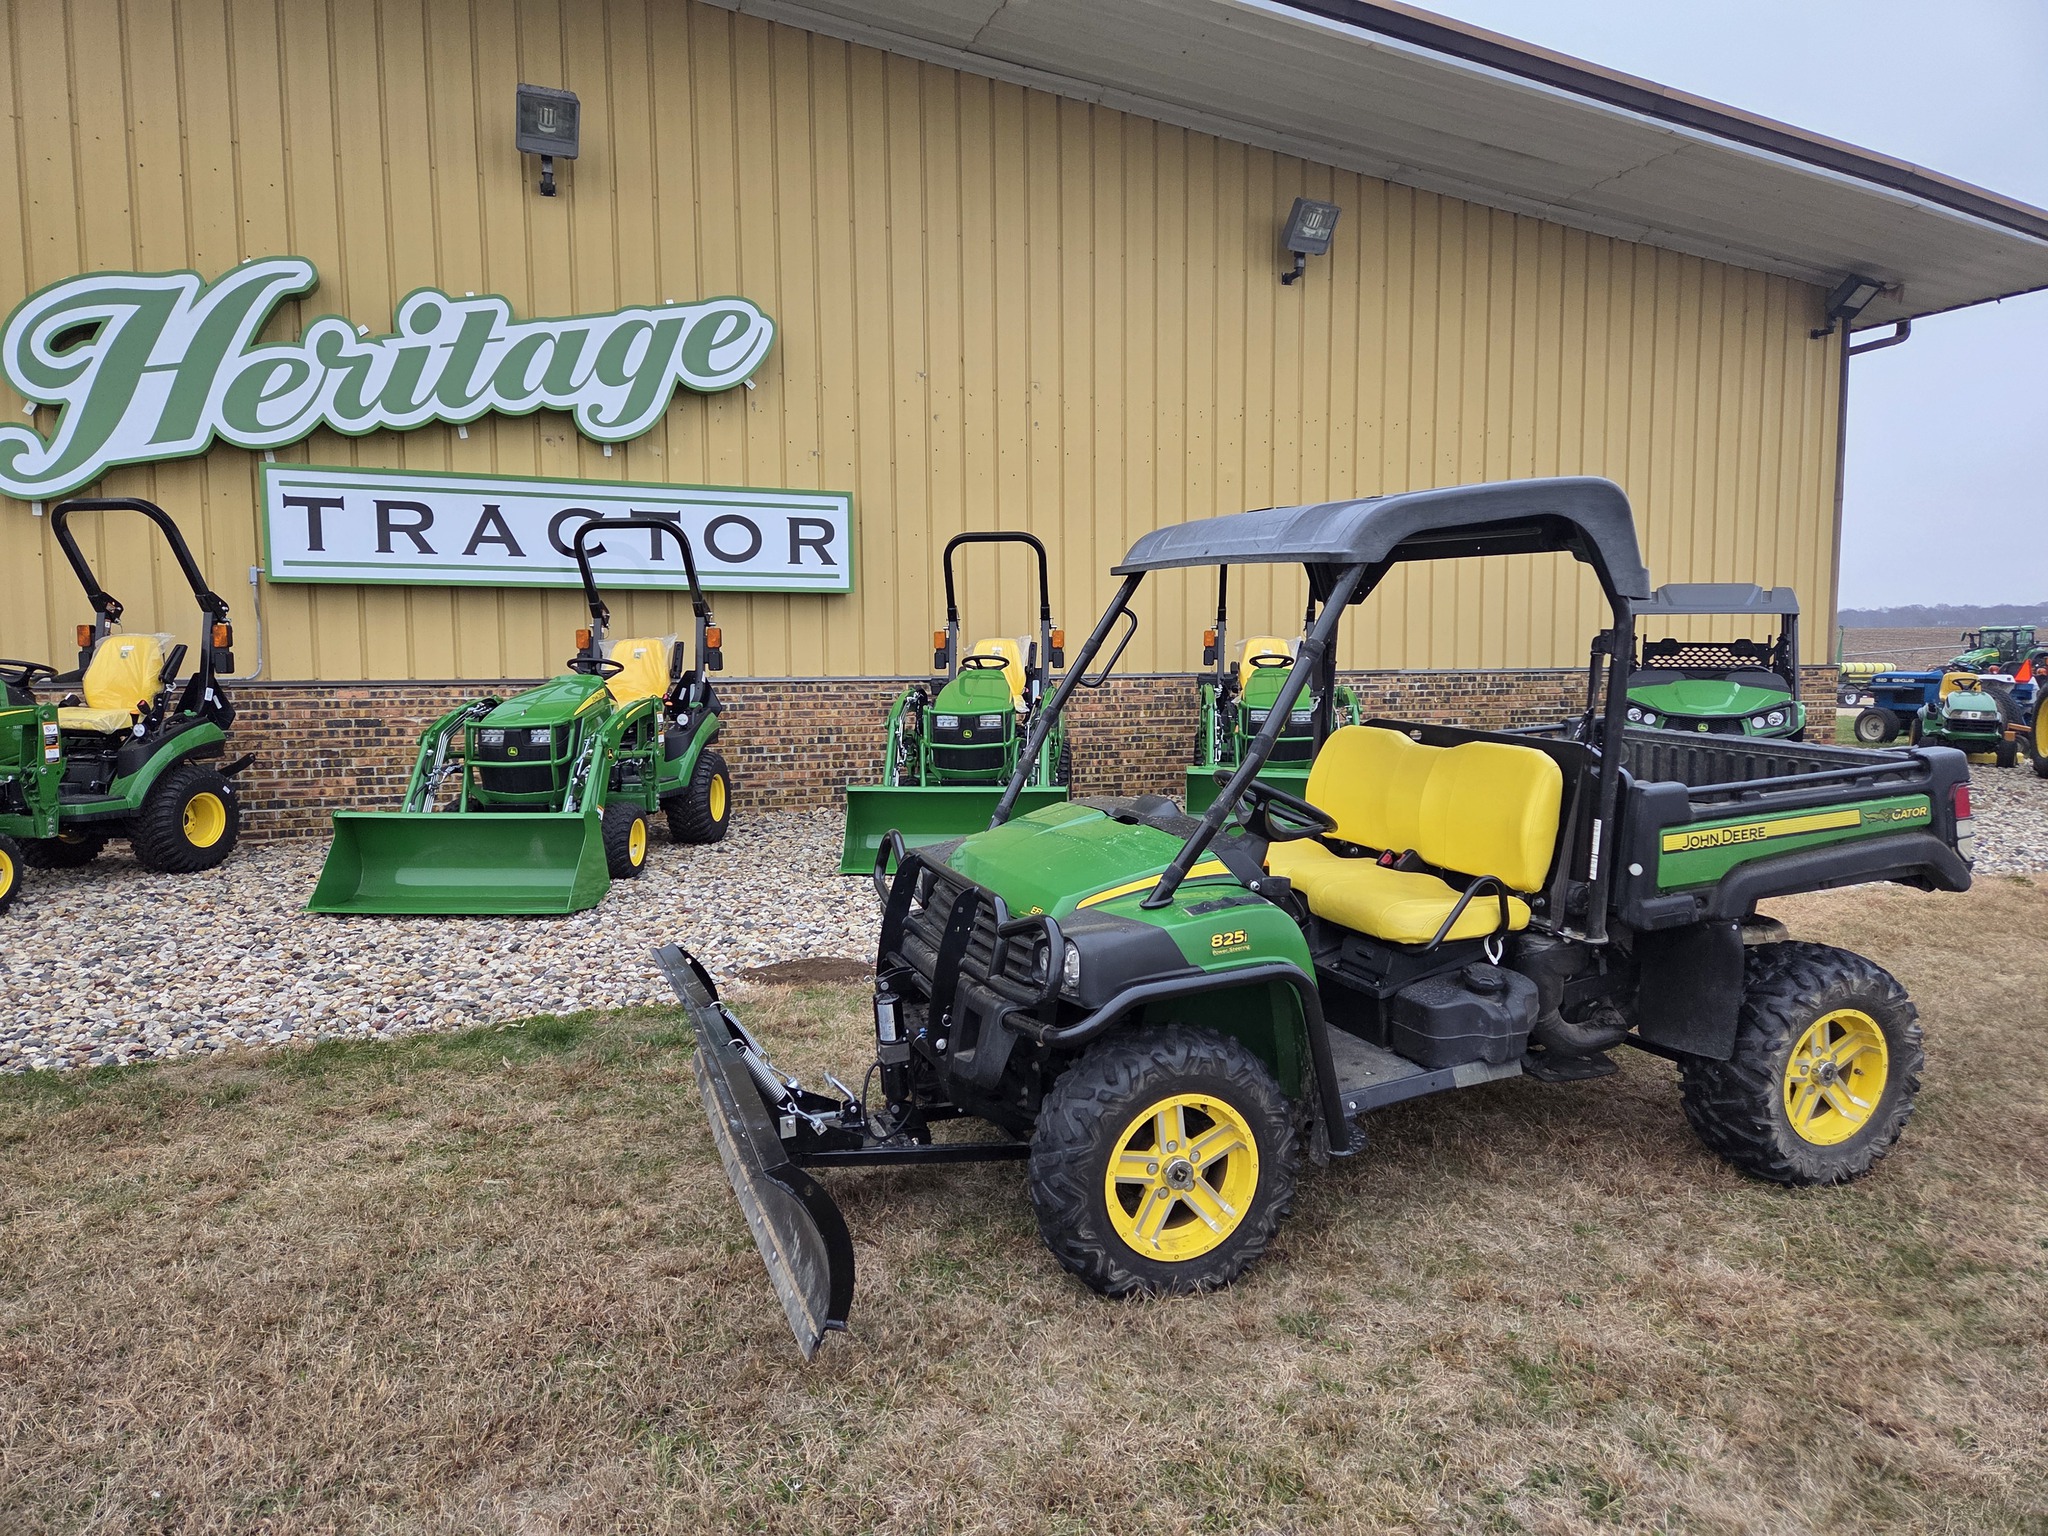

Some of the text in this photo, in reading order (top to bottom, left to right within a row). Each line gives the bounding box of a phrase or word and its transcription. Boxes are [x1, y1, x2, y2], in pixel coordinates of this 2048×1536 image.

[0, 266, 766, 482] Heritage
[282, 493, 838, 566] TRACTOR
[1891, 805, 1928, 821] GATOR
[1682, 826, 1766, 849] JOHN DEERE
[1211, 930, 1248, 948] 825i
